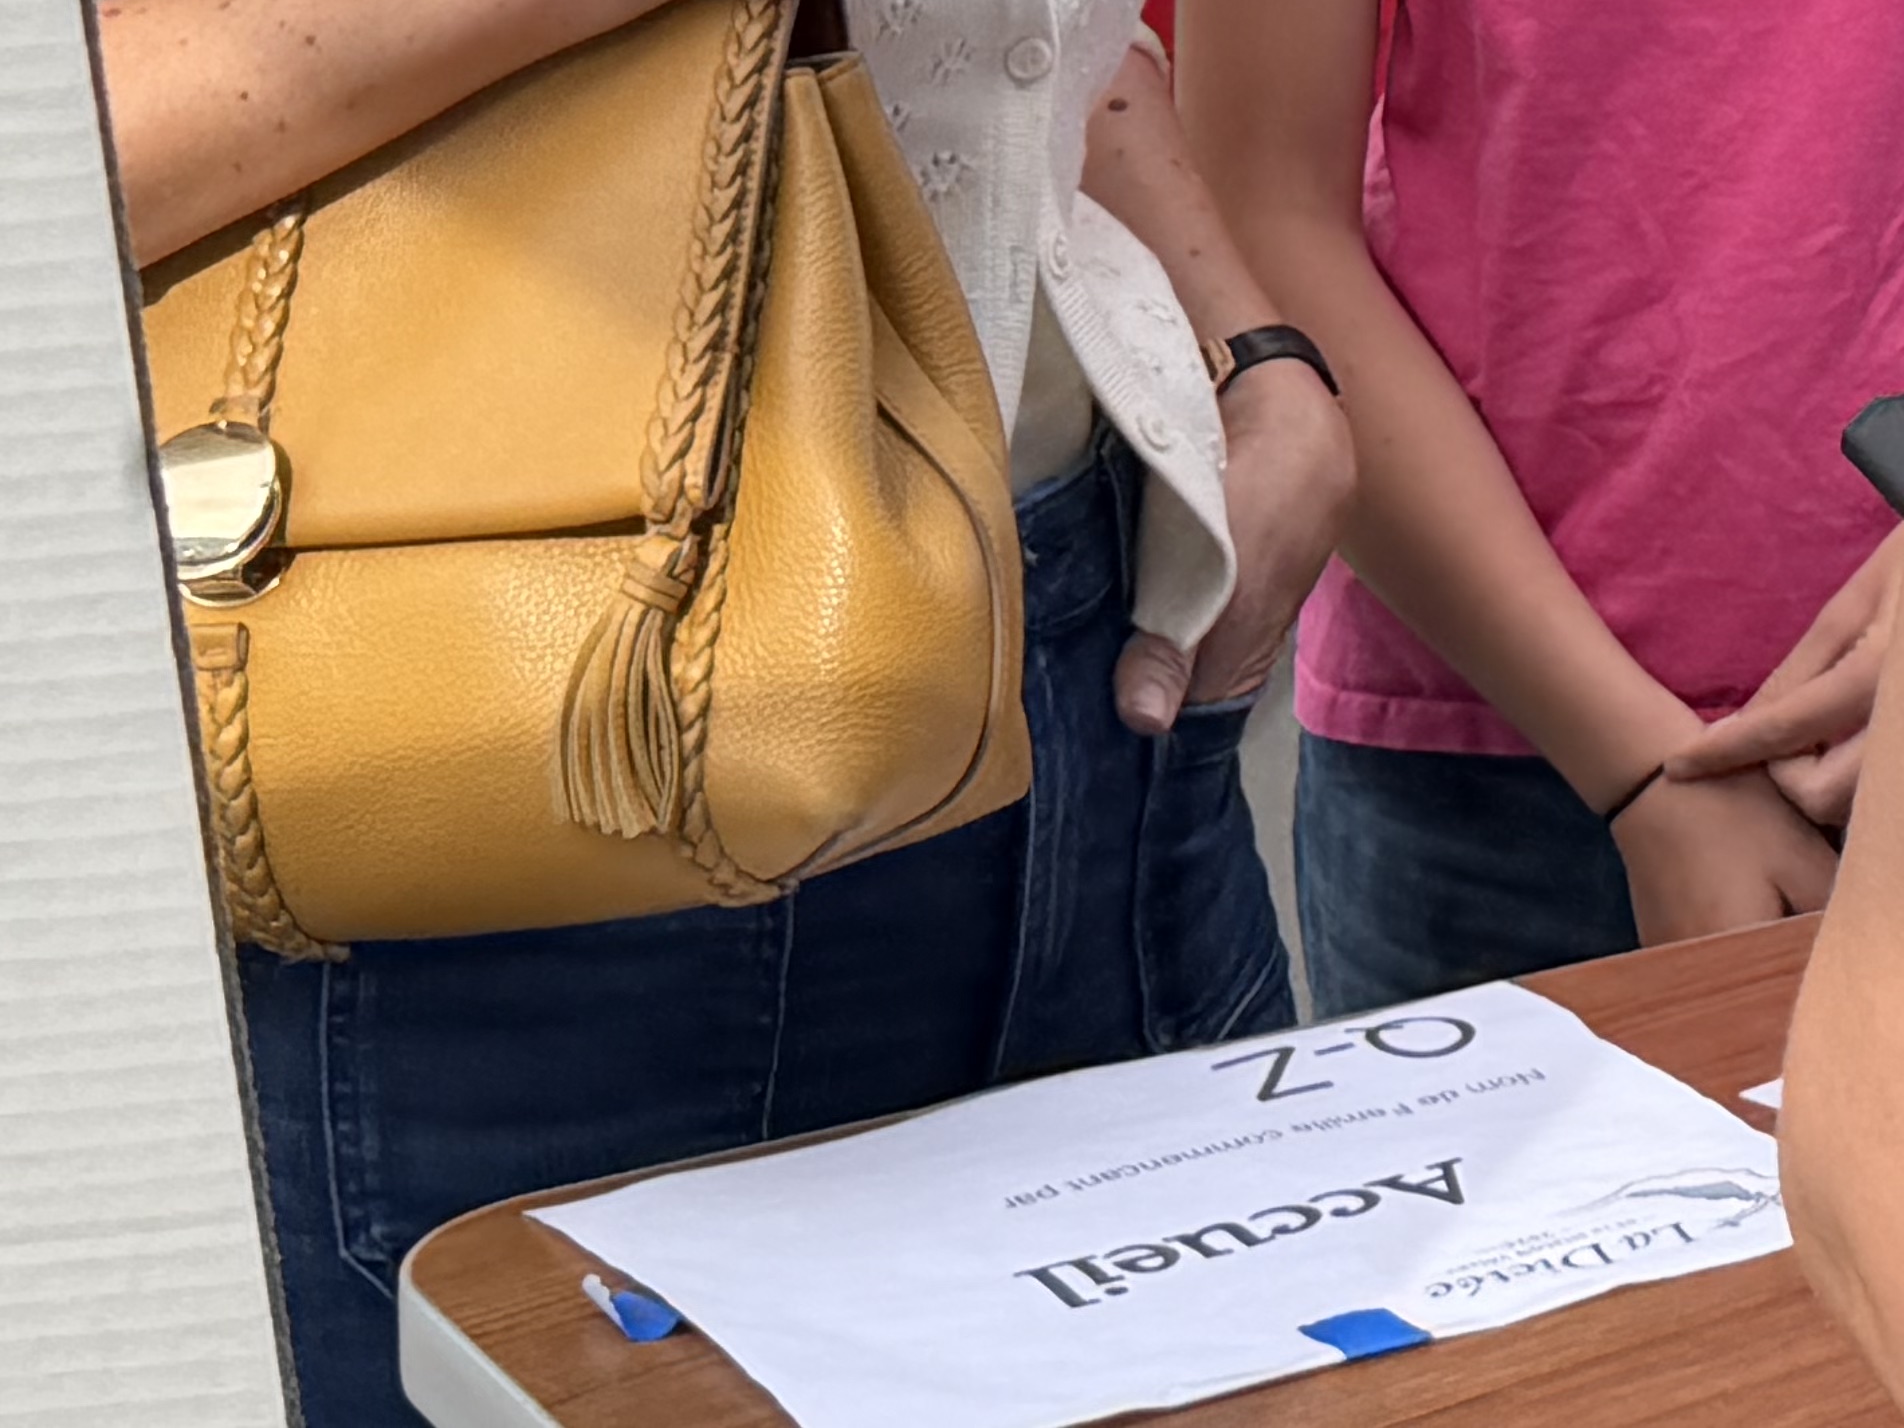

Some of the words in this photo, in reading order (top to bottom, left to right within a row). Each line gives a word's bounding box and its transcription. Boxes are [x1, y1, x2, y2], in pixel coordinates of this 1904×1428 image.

[1211, 1014, 1477, 1106] Q-Z
[1002, 1182, 1061, 1210] par
[1012, 1156, 1466, 1309] Accueil
[1619, 1221, 1698, 1251] La
